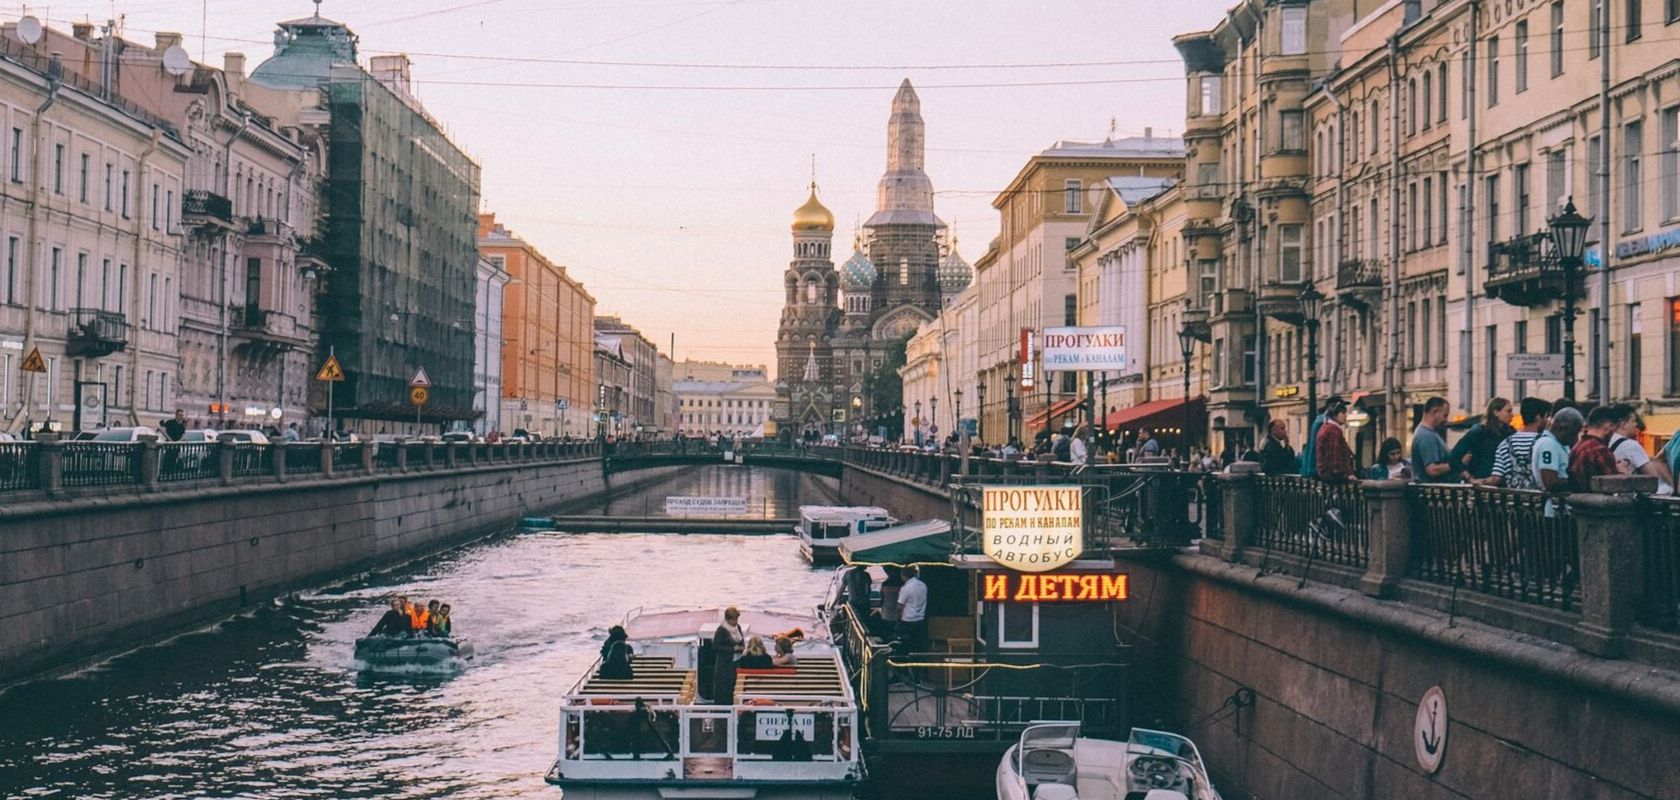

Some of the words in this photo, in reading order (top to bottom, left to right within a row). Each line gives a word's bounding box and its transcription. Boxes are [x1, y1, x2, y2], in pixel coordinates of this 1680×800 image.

[1045, 334, 1124, 348] ПРОГУЛКИ
[1053, 354, 1080, 363] РЕКАМ
[1086, 353, 1124, 363] КАНАЛАМ
[414, 391, 425, 400] 40
[985, 490, 1080, 512] ПРОГУЛКИ
[985, 517, 996, 529] ПО
[999, 517, 1027, 529] РЕКАМ
[993, 533, 1074, 547] ВОДНЫЙ
[993, 548, 1074, 563] АВТОБУС
[984, 574, 1008, 600] И
[1014, 574, 1128, 601] ДЕТЯМ
[918, 726, 953, 738] 91-75
[956, 726, 974, 738] ЛД
